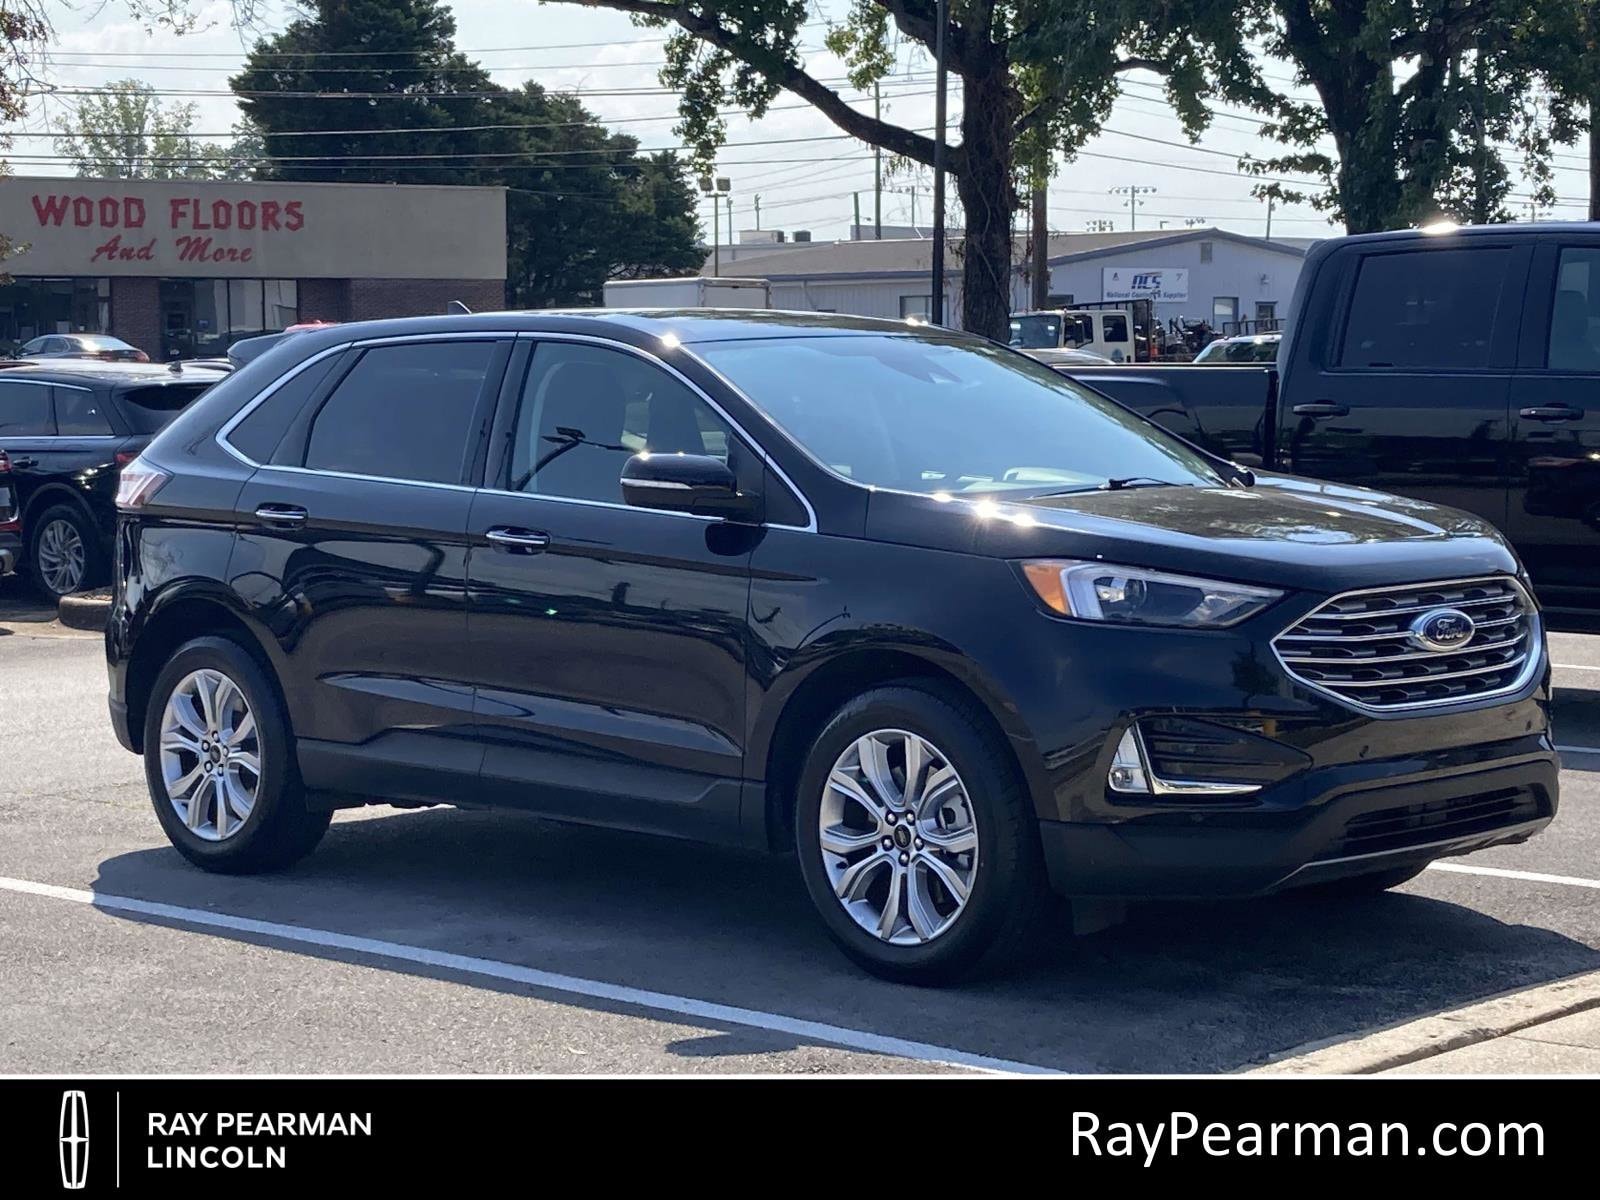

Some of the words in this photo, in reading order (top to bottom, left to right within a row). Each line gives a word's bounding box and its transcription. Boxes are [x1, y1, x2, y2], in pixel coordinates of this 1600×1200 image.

[32, 195, 146, 228] WOOD
[169, 198, 305, 231] FLOORS
[91, 234, 157, 263] And
[176, 235, 254, 263] More
[1436, 618, 1465, 640] Ford
